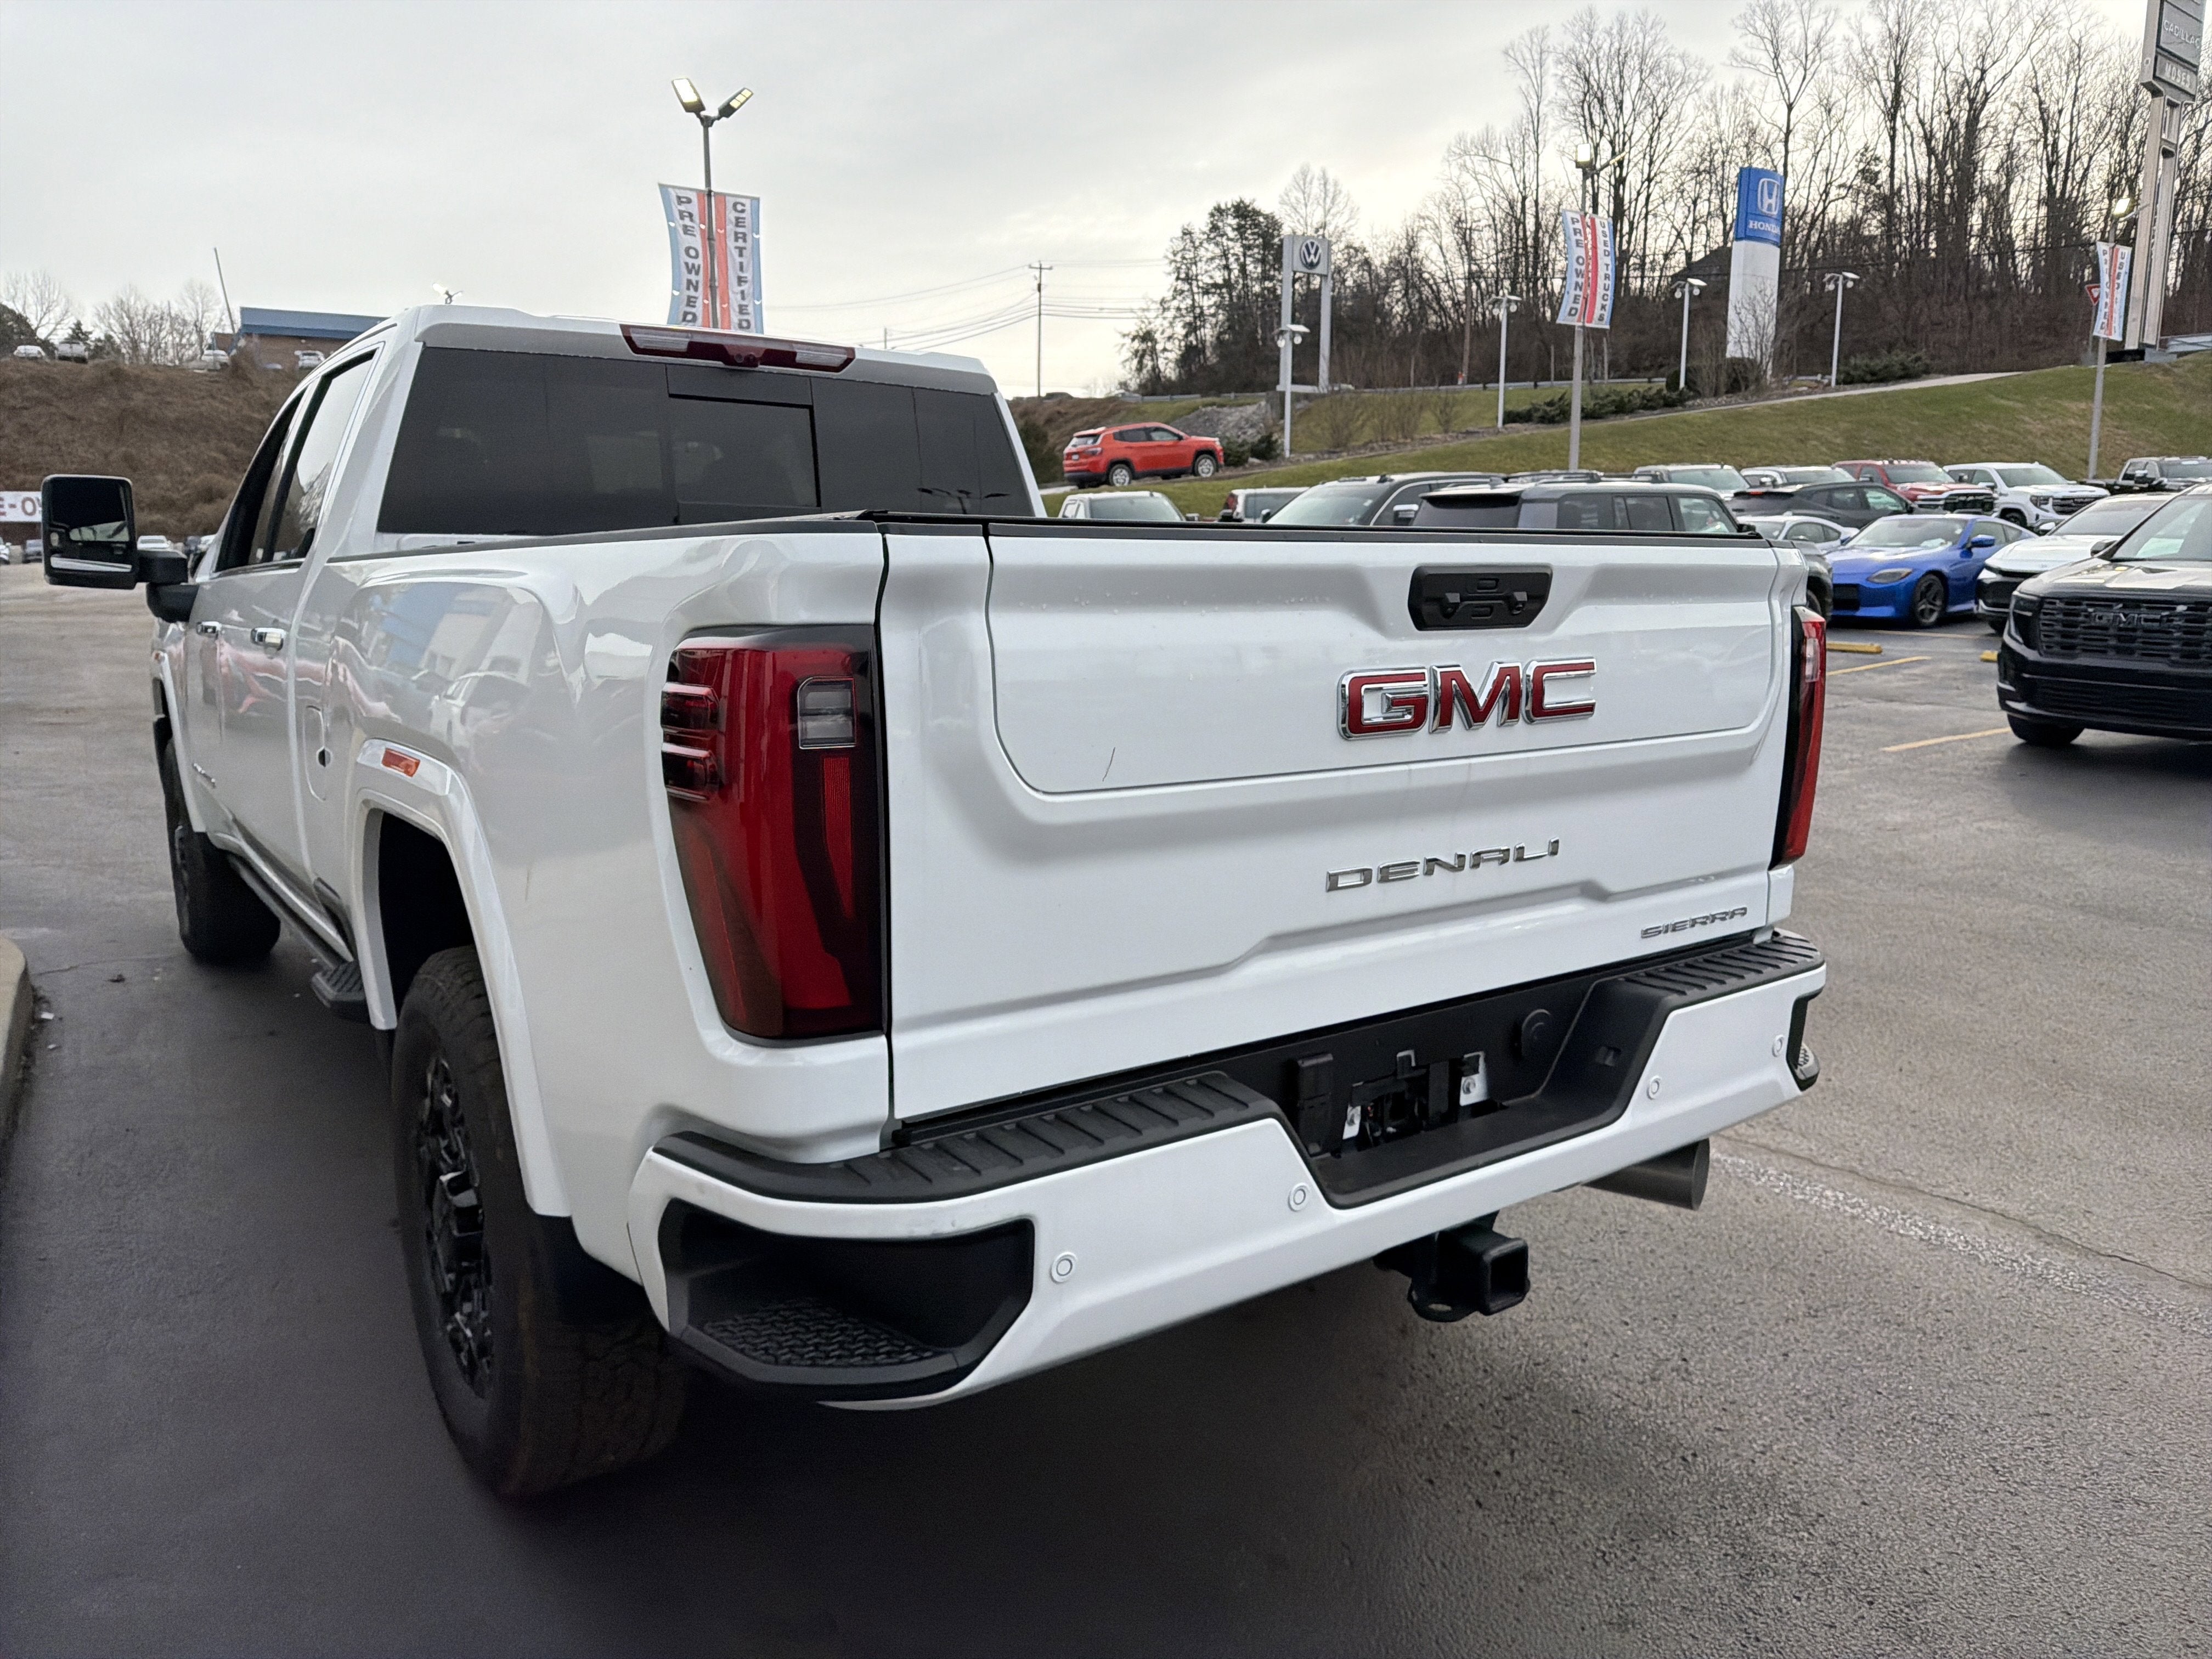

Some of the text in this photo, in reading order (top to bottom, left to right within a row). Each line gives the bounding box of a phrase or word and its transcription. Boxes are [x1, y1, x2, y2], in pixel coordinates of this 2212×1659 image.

[2164, 20, 2200, 49] CADILLAC
[676, 195, 701, 324] PRE OWNED
[732, 201, 751, 330] CERTIFIED
[1567, 217, 1585, 317] PRE OWNED
[1598, 221, 1610, 322] USED TRUCKS
[1337, 657, 1597, 740] GMC
[1325, 837, 1559, 893] DENALI
[1641, 907, 1747, 939] SIERRA
